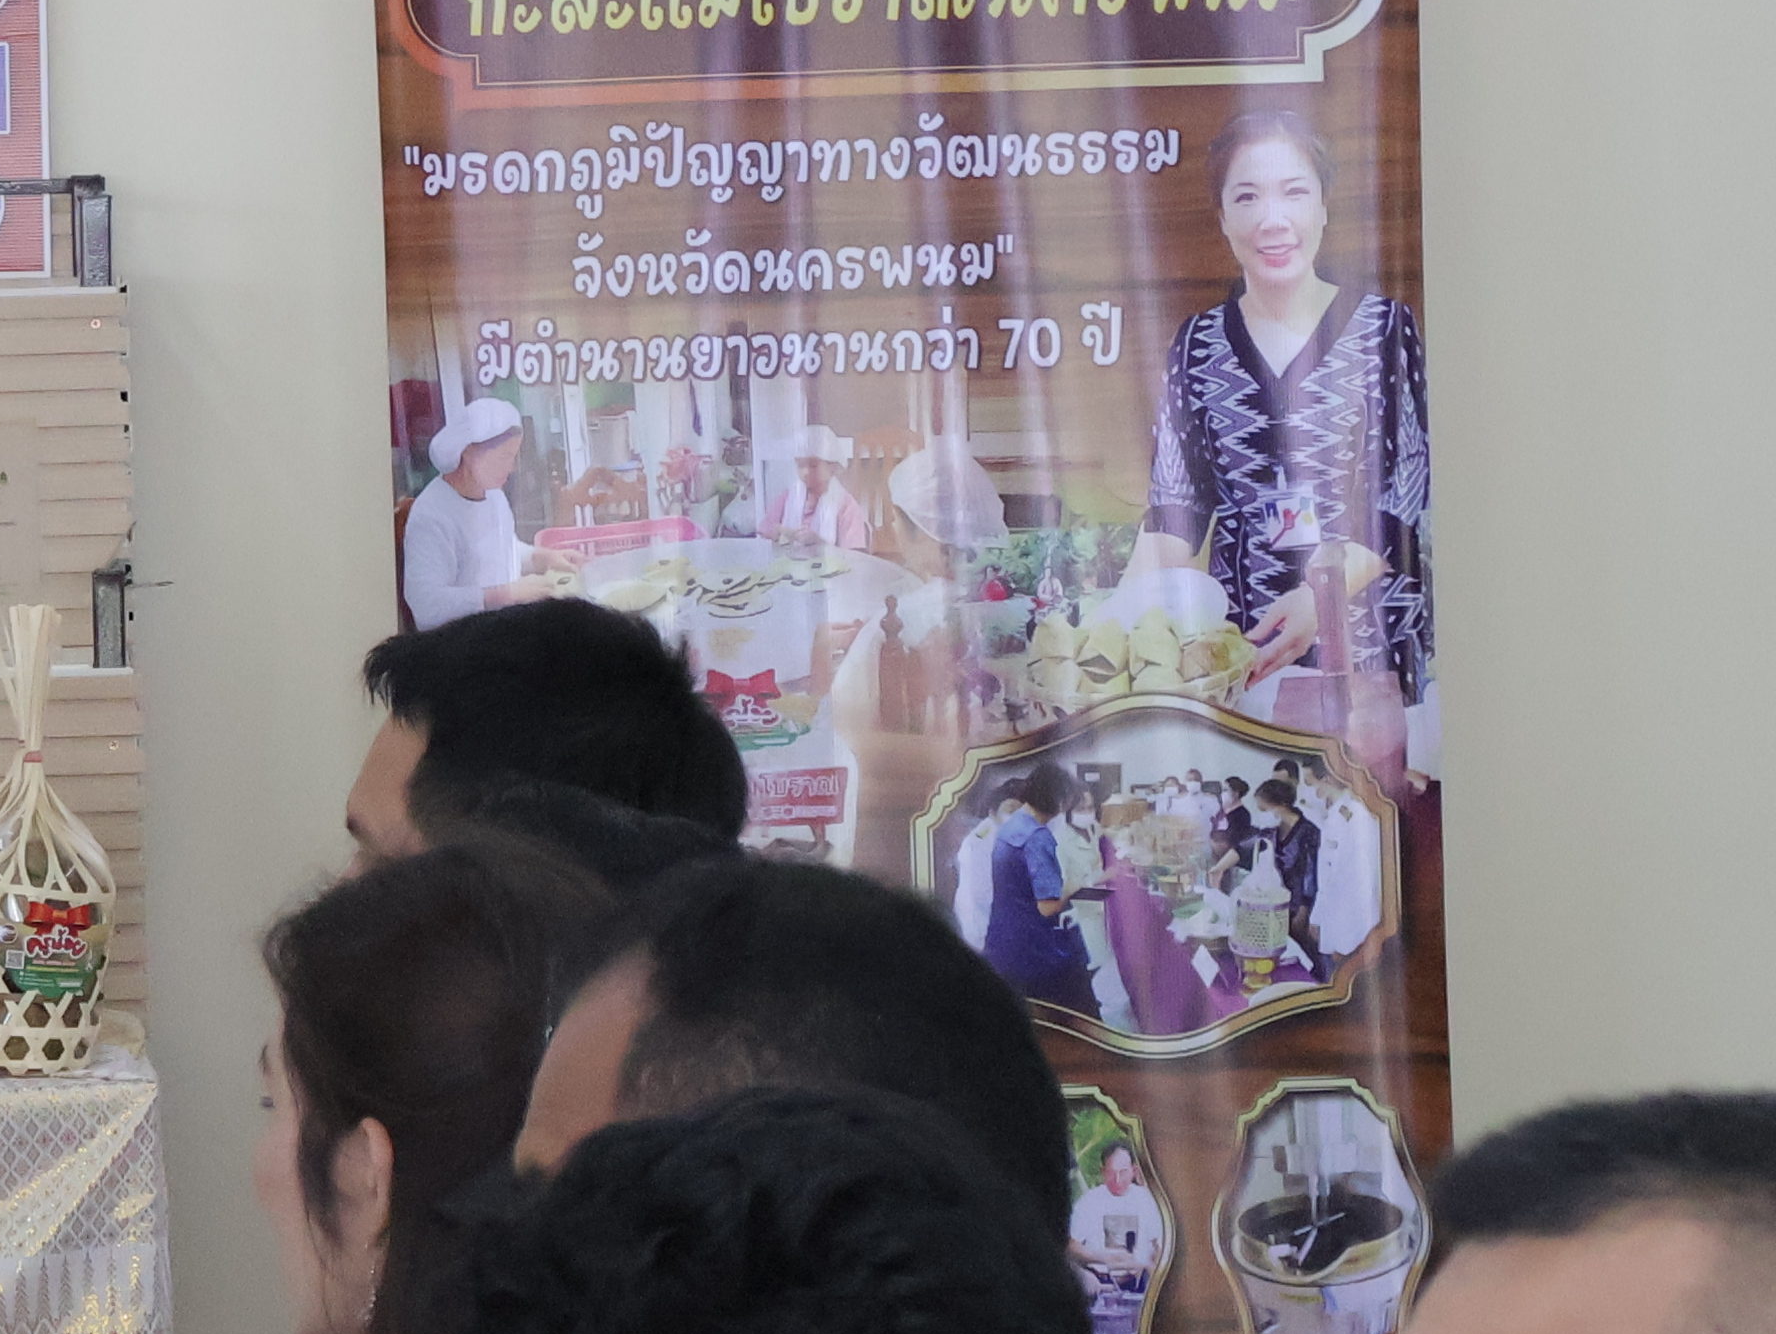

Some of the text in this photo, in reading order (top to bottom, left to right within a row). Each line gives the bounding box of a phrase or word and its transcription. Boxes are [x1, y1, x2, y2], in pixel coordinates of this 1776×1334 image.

[403, 112, 1181, 220] "มรดกภูมิปัญญาทางวัฒนธรรม
[571, 228, 1015, 299] จังหวัดนครพนม"
[478, 300, 1123, 387] มีตำนานยาวนานกว่า 70 ปี
